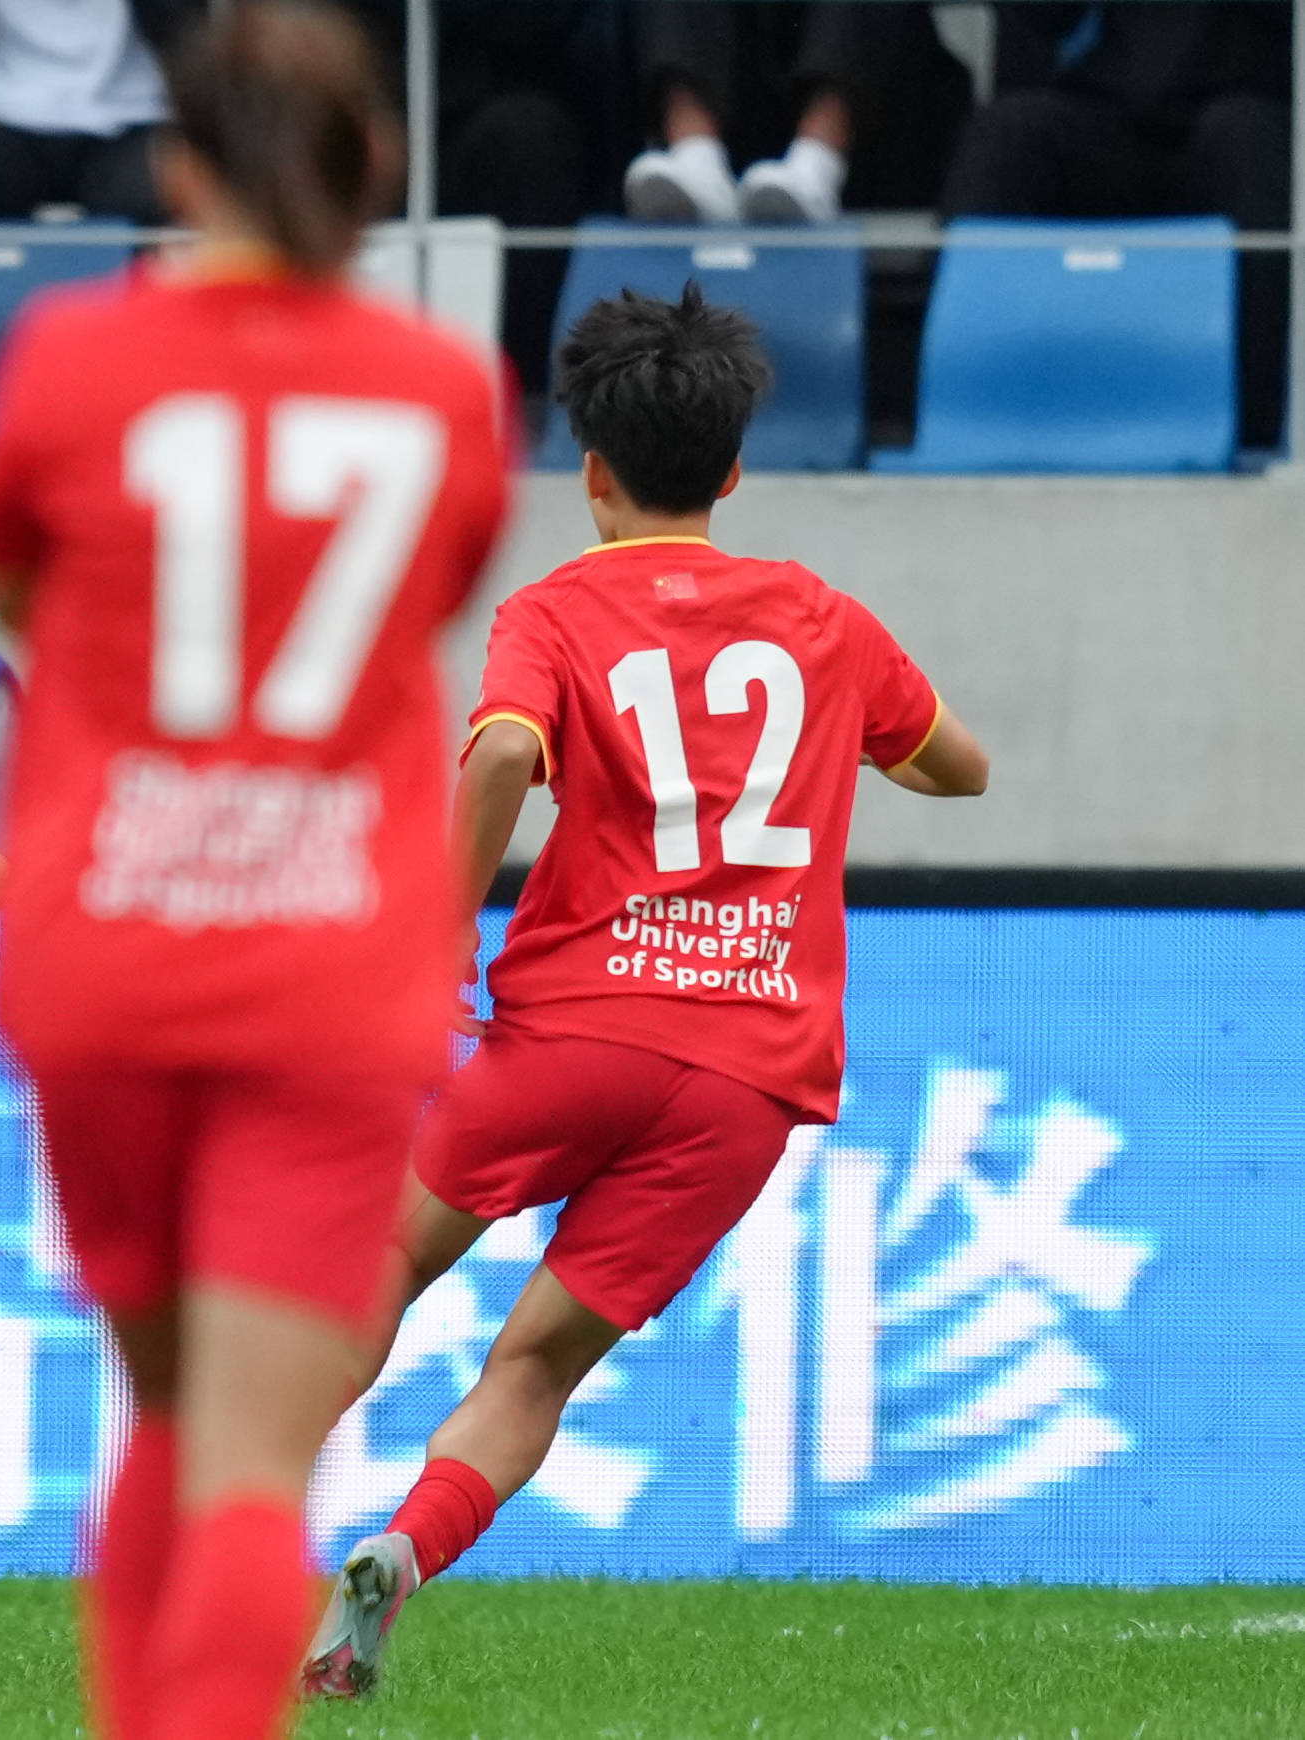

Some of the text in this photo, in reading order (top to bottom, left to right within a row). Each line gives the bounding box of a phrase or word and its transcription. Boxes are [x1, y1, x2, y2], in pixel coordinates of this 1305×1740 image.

[124, 392, 449, 740] 17
[607, 640, 811, 873] 12
[607, 951, 798, 1001] of Sport(H)
[611, 917, 791, 971] University
